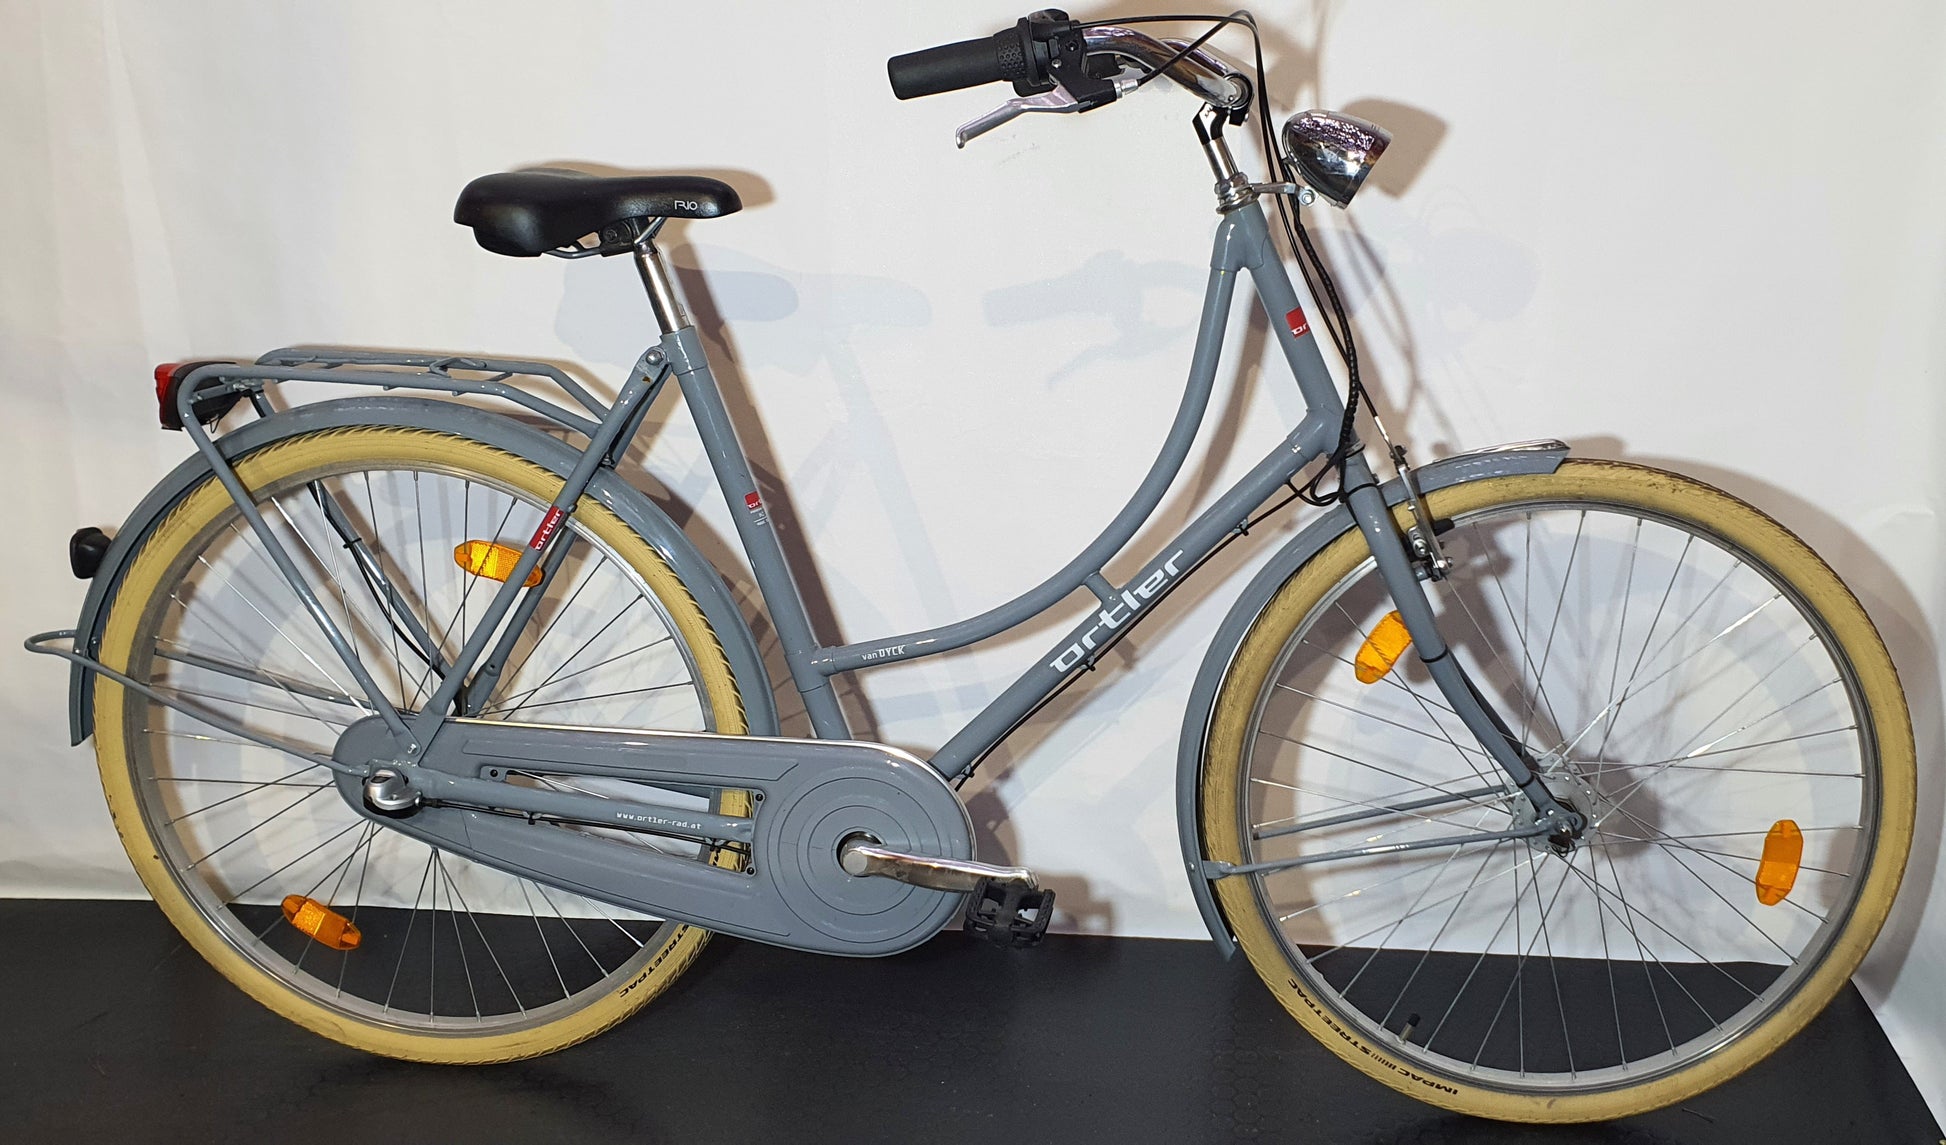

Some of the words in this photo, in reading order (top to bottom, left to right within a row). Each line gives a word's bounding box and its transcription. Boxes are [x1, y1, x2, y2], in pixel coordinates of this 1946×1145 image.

[674, 200, 698, 210] RIO
[534, 508, 561, 550] ortler
[1050, 549, 1184, 673] ortler
[861, 652, 878, 661] van
[878, 644, 906, 658] DYCK
[616, 811, 702, 830] www.ortler-rad.at
[1287, 978, 1372, 1056] STREETPAC
[1397, 1067, 1459, 1095] IMPAC
